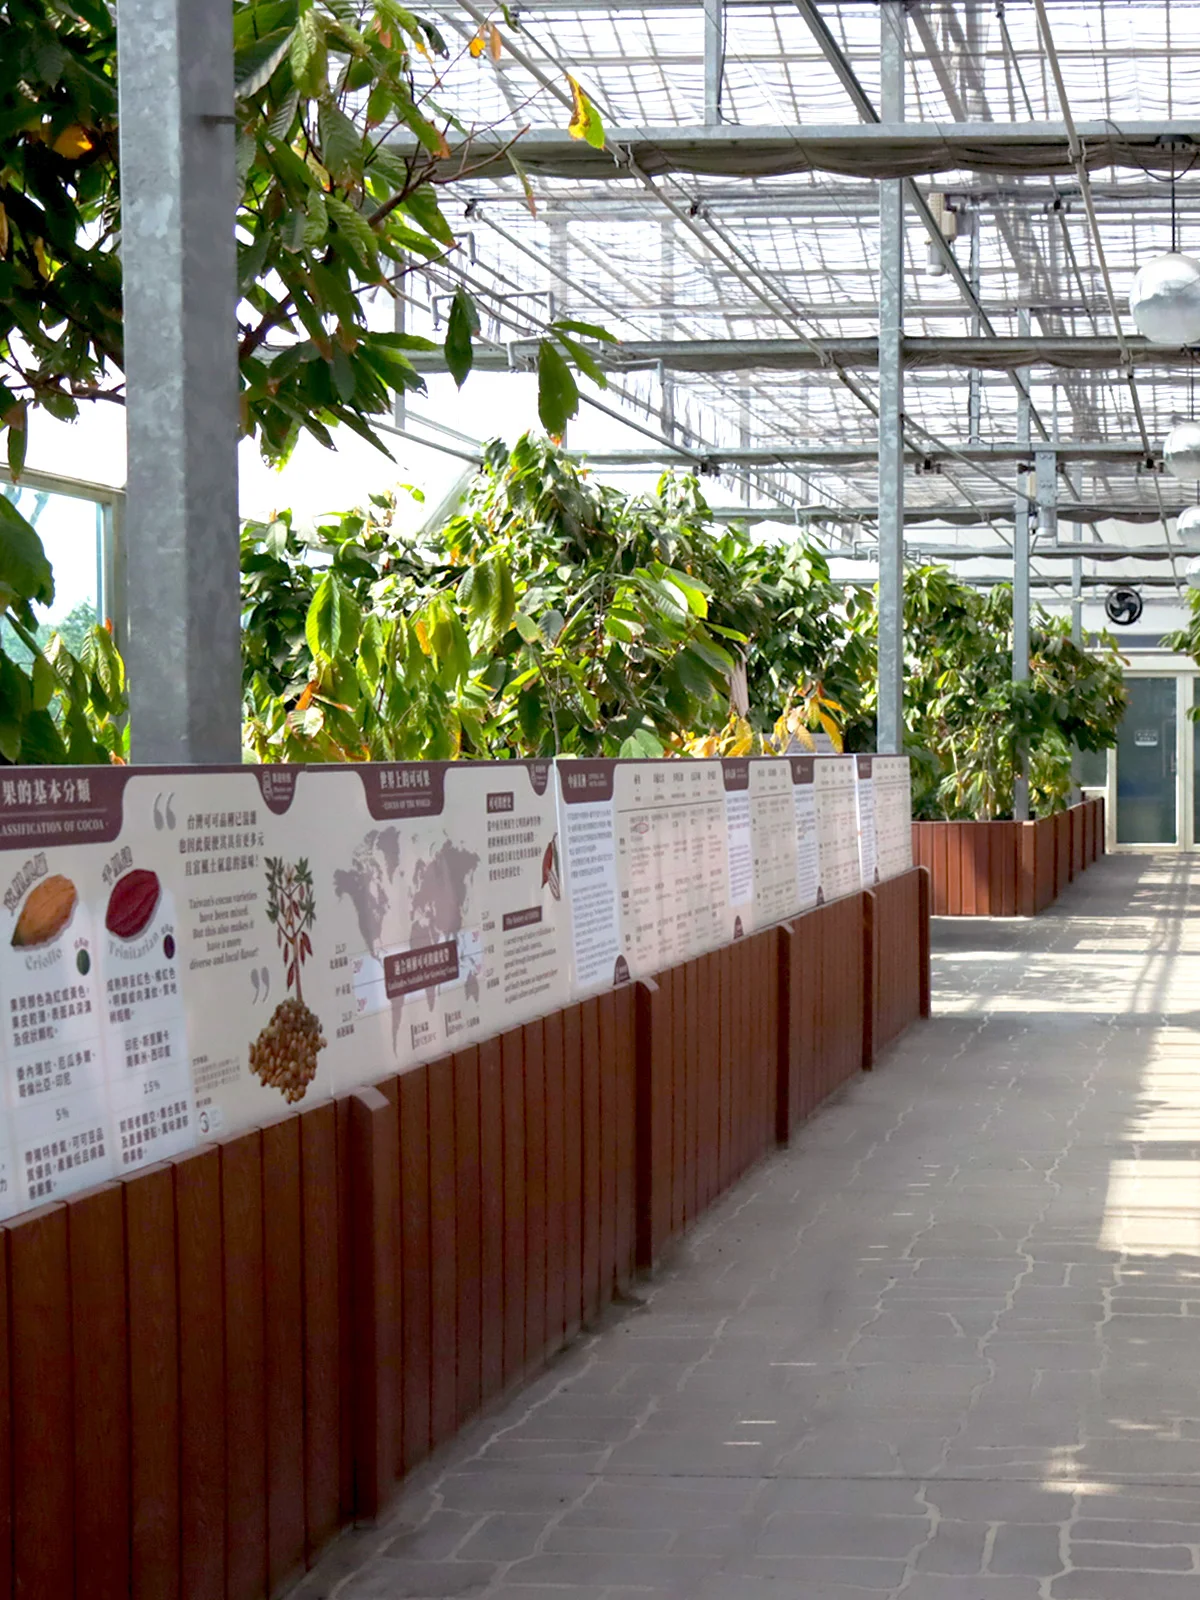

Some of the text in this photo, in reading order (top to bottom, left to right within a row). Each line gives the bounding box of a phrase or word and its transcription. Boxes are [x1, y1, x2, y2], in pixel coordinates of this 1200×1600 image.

[3, 778, 91, 806] 果的基本分類
[0, 819, 104, 836] ASSIFICATION OF COCOA
[143, 1080, 161, 1094] 15%
